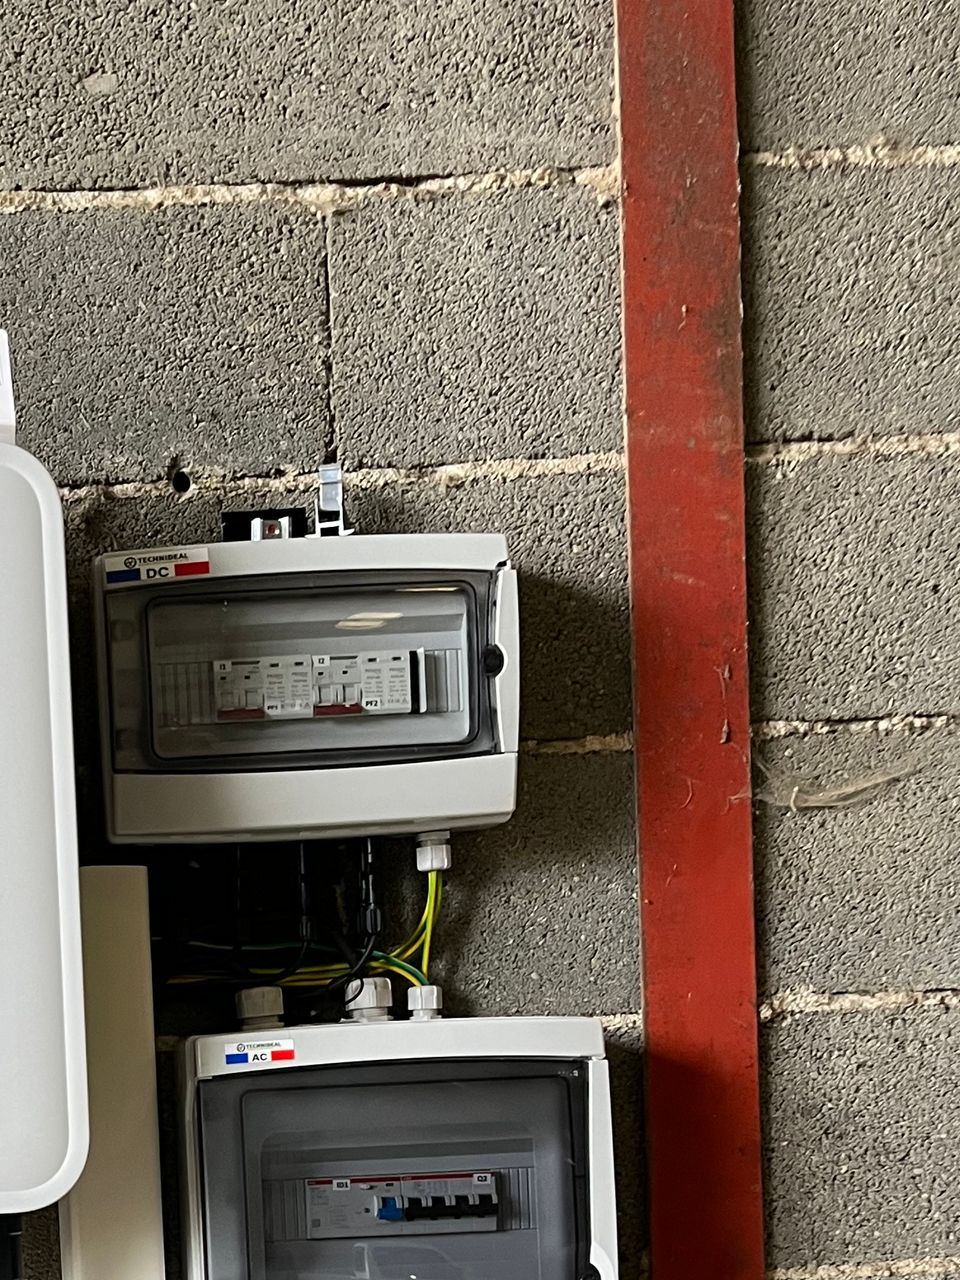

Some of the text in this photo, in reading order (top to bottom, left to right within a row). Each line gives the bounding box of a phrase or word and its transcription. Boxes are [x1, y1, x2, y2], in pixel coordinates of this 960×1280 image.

[138, 553, 188, 563] TECHNIDEAL
[146, 567, 169, 578] DC
[252, 1053, 268, 1062] AC
